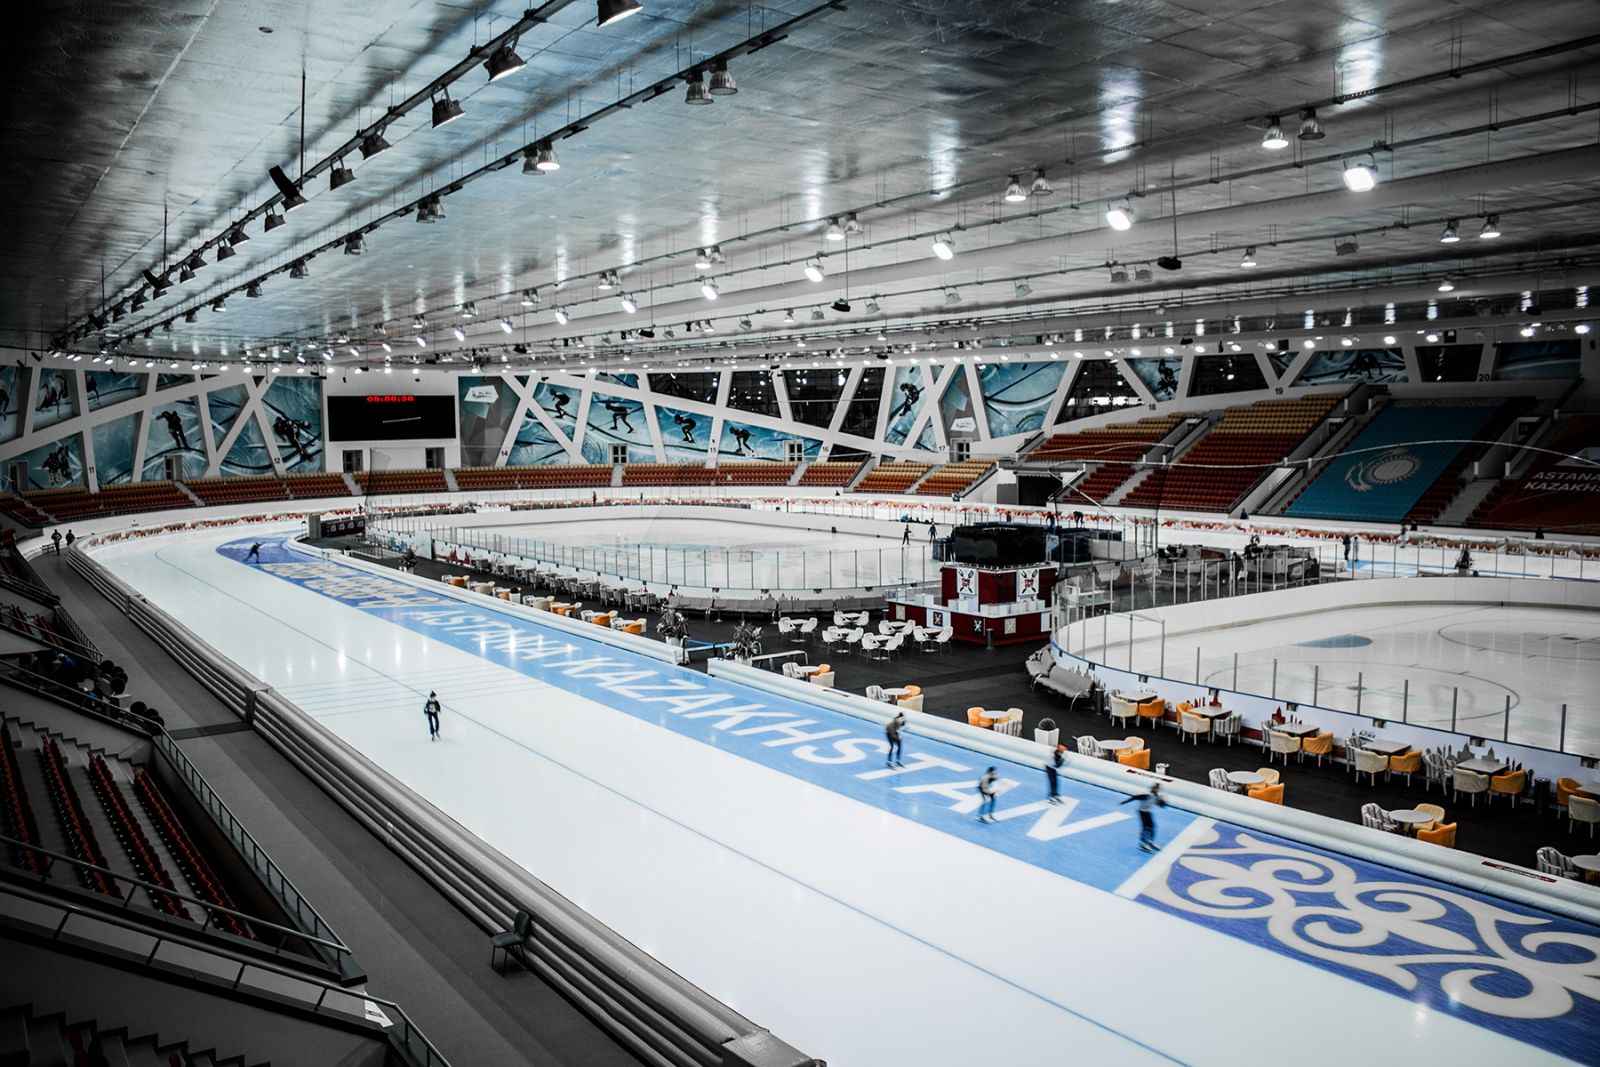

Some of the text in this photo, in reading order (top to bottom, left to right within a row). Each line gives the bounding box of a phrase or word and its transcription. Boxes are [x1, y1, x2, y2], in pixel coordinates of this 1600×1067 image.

[1478, 373, 1490, 382] 20
[1275, 387, 1284, 395] 19
[1532, 471, 1600, 480] ASTANA
[402, 609, 1134, 841] ASTANA KAZAKHSTAN
